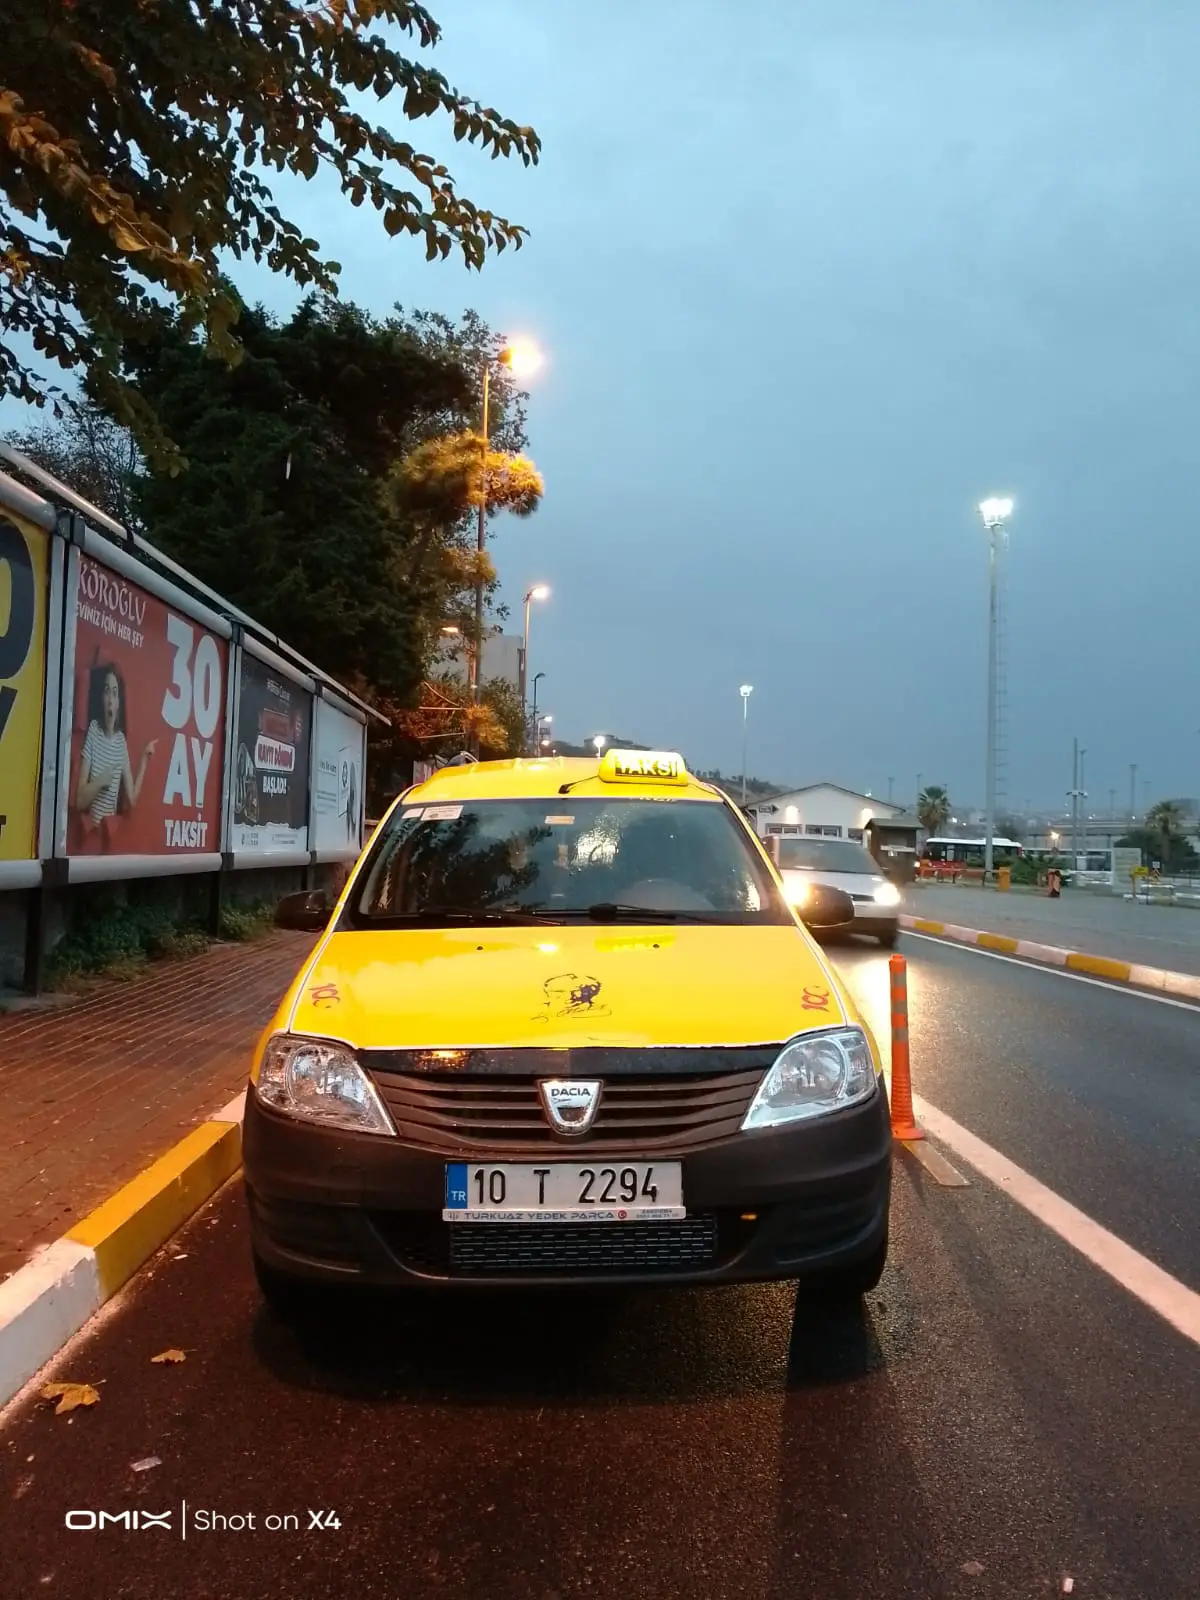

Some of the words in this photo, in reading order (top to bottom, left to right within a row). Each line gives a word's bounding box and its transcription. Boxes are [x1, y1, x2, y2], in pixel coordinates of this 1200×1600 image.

[117, 622, 132, 643] HER
[162, 613, 221, 739] 30
[163, 733, 213, 809] AY
[165, 813, 208, 848] TAKSİT
[551, 1088, 591, 1096] DACIA
[451, 1191, 466, 1201] TR
[474, 1168, 506, 1204] 10
[533, 1169, 550, 1204] T
[578, 1167, 658, 1203] 2294
[527, 1211, 568, 1220] YEDEK
